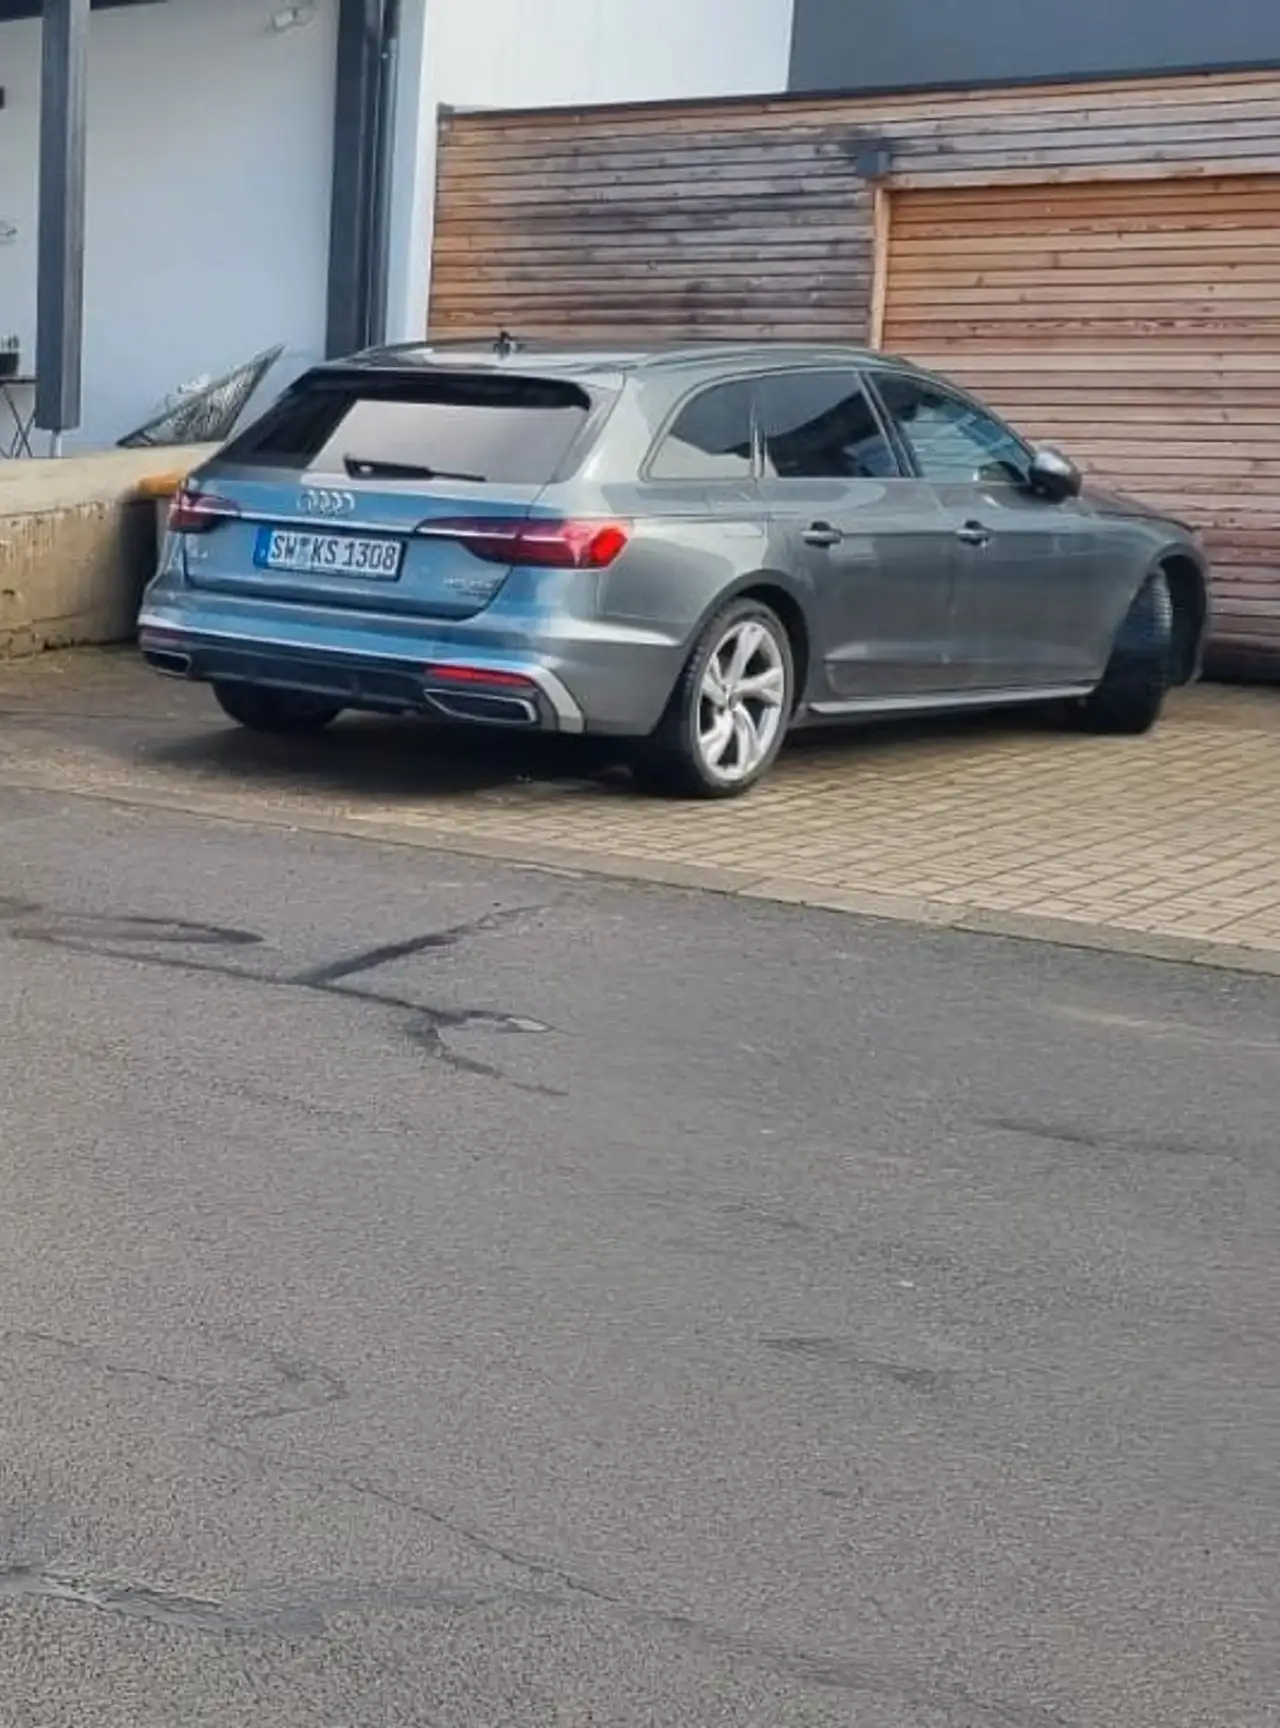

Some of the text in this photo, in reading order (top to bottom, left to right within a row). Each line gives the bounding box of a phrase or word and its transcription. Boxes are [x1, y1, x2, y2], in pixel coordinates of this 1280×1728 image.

[271, 535, 396, 571] SW KS 1308
